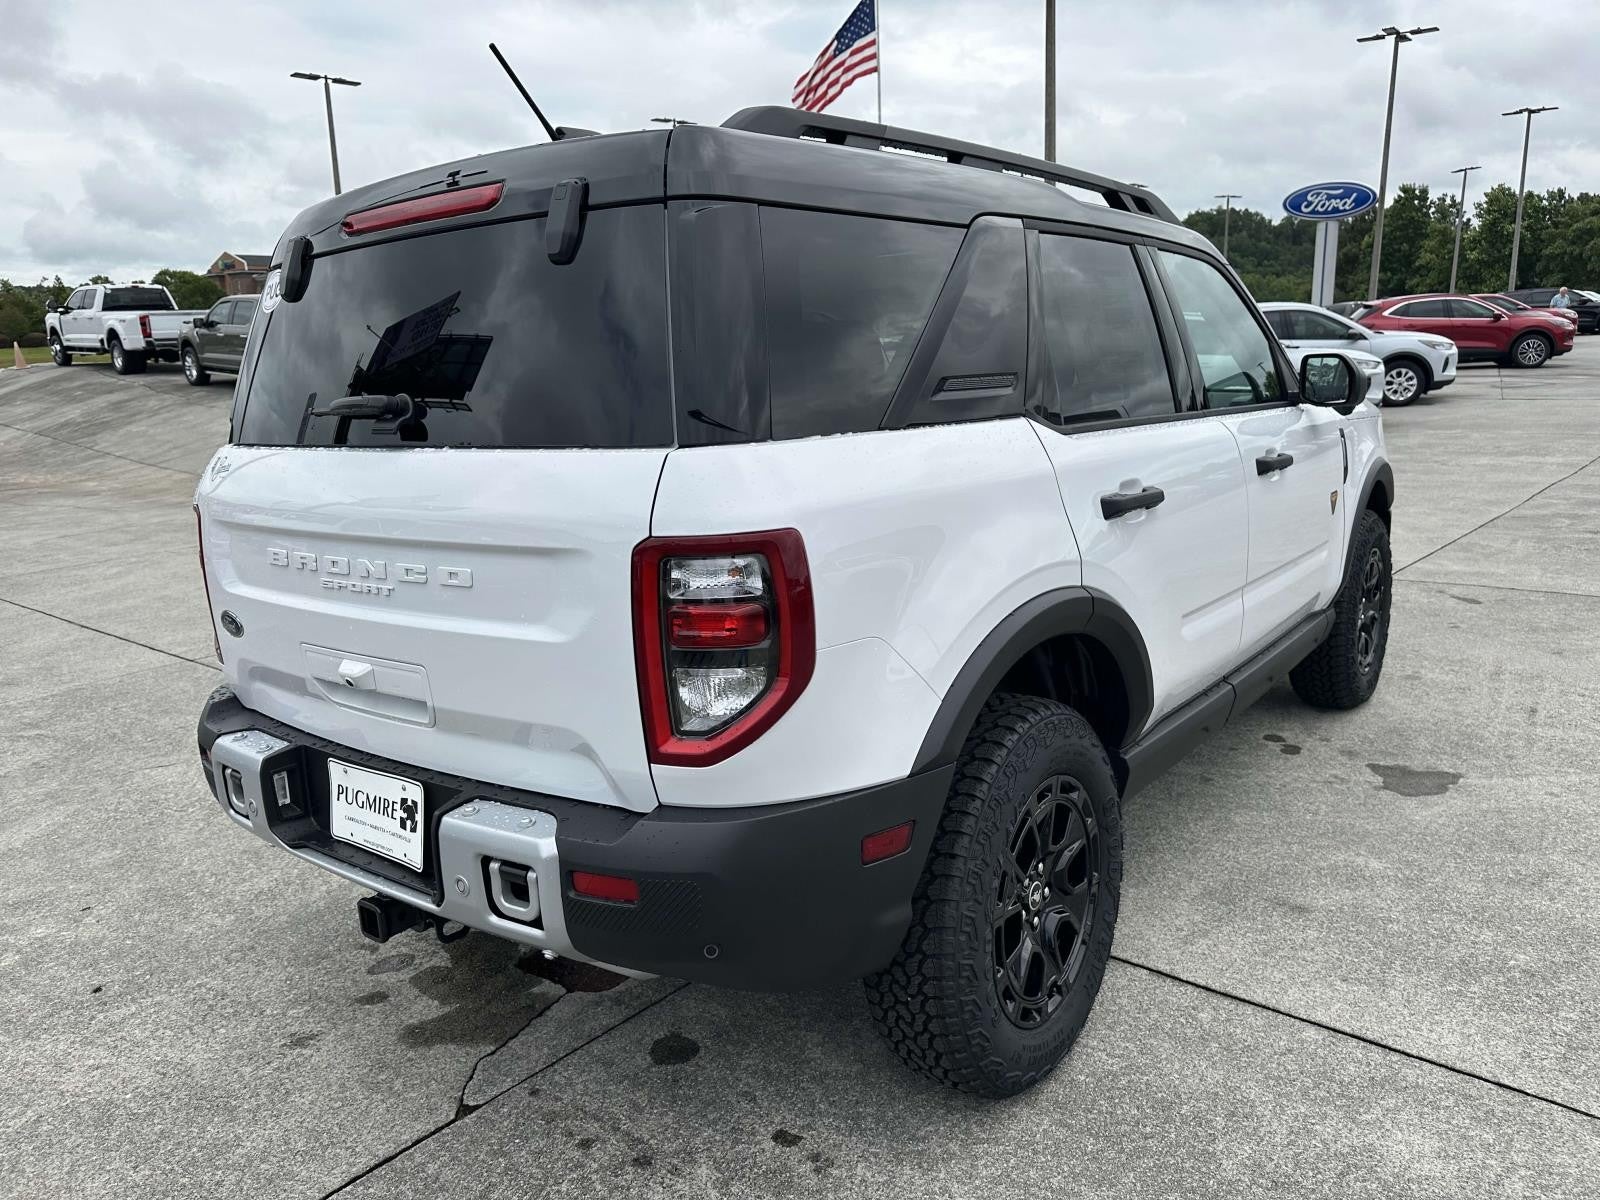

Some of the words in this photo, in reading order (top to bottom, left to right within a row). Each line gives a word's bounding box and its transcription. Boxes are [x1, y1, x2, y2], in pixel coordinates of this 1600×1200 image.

[1301, 189, 1357, 213] Ford
[266, 547, 473, 588] BRONCO
[319, 577, 395, 596] SPORT
[336, 784, 399, 820] PUGMIRE
